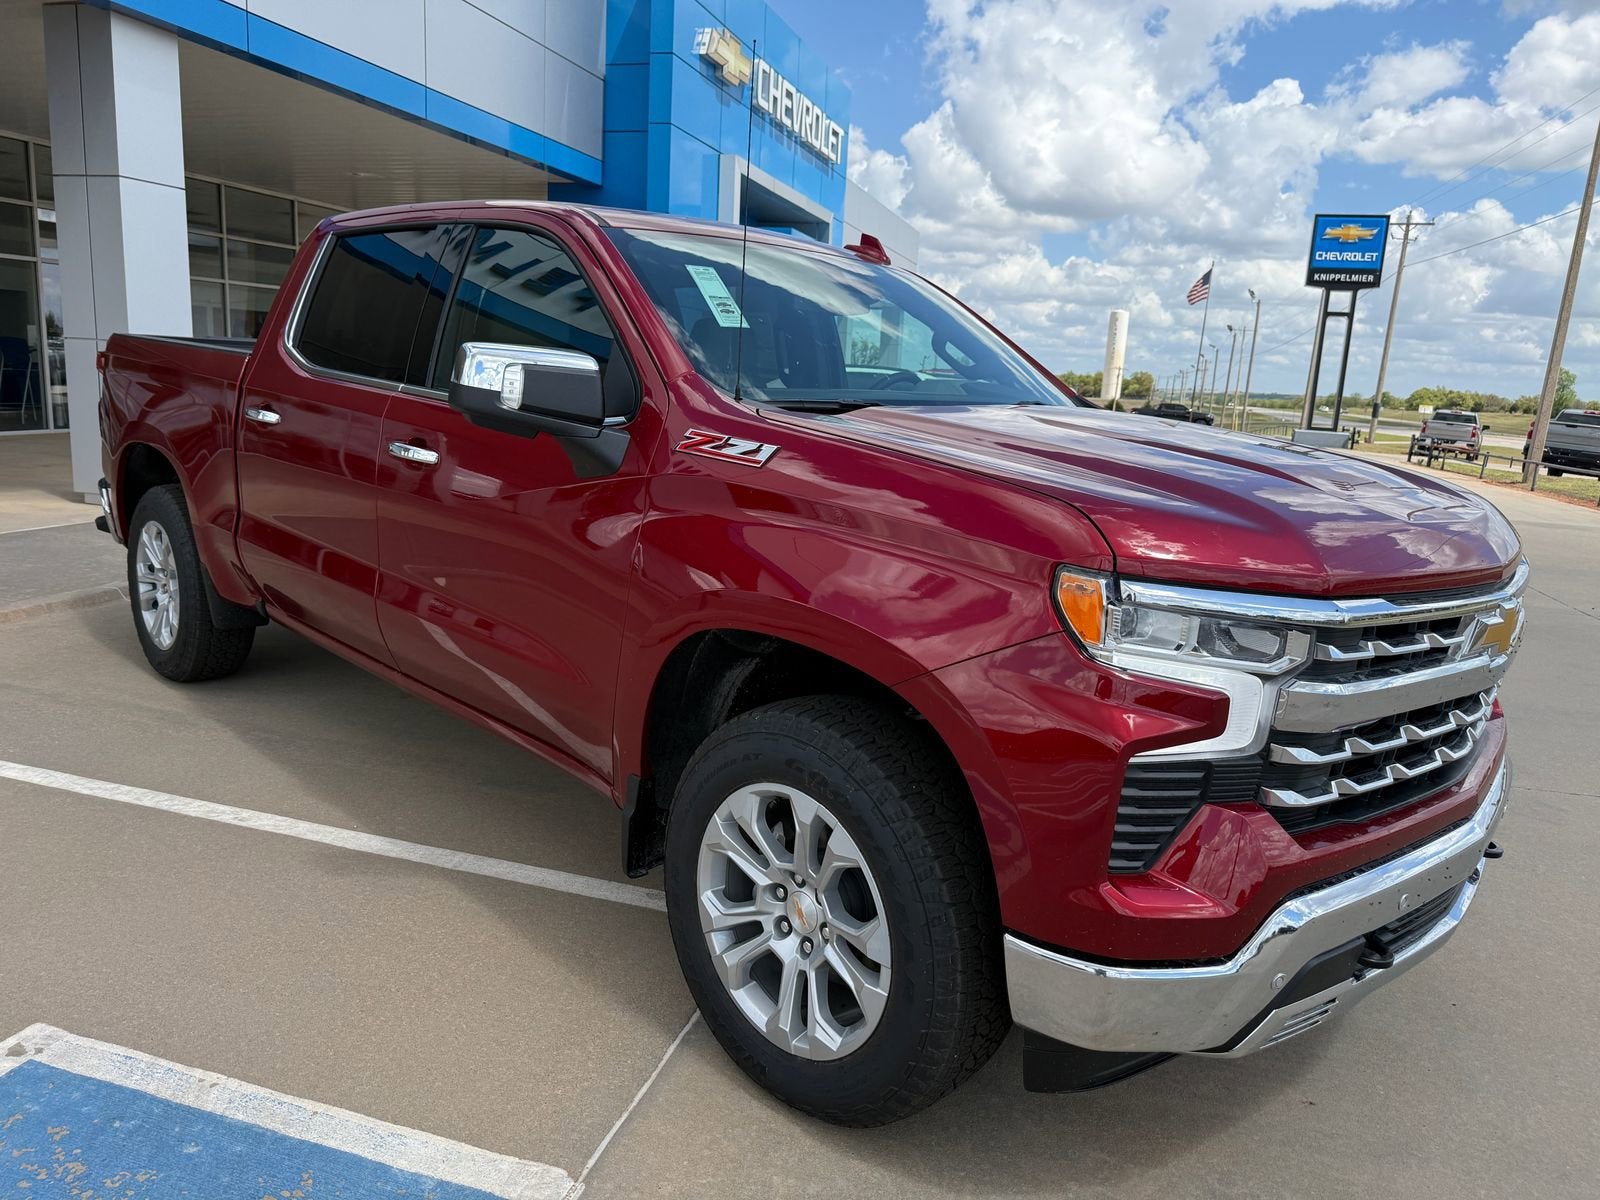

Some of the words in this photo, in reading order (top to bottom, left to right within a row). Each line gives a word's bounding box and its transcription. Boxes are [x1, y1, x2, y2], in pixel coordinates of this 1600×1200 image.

[754, 58, 845, 165] CHEVROLET
[1315, 251, 1379, 262] CHEVROLET
[1313, 273, 1374, 283] KNIPPELMIER
[673, 428, 781, 468] Z71
